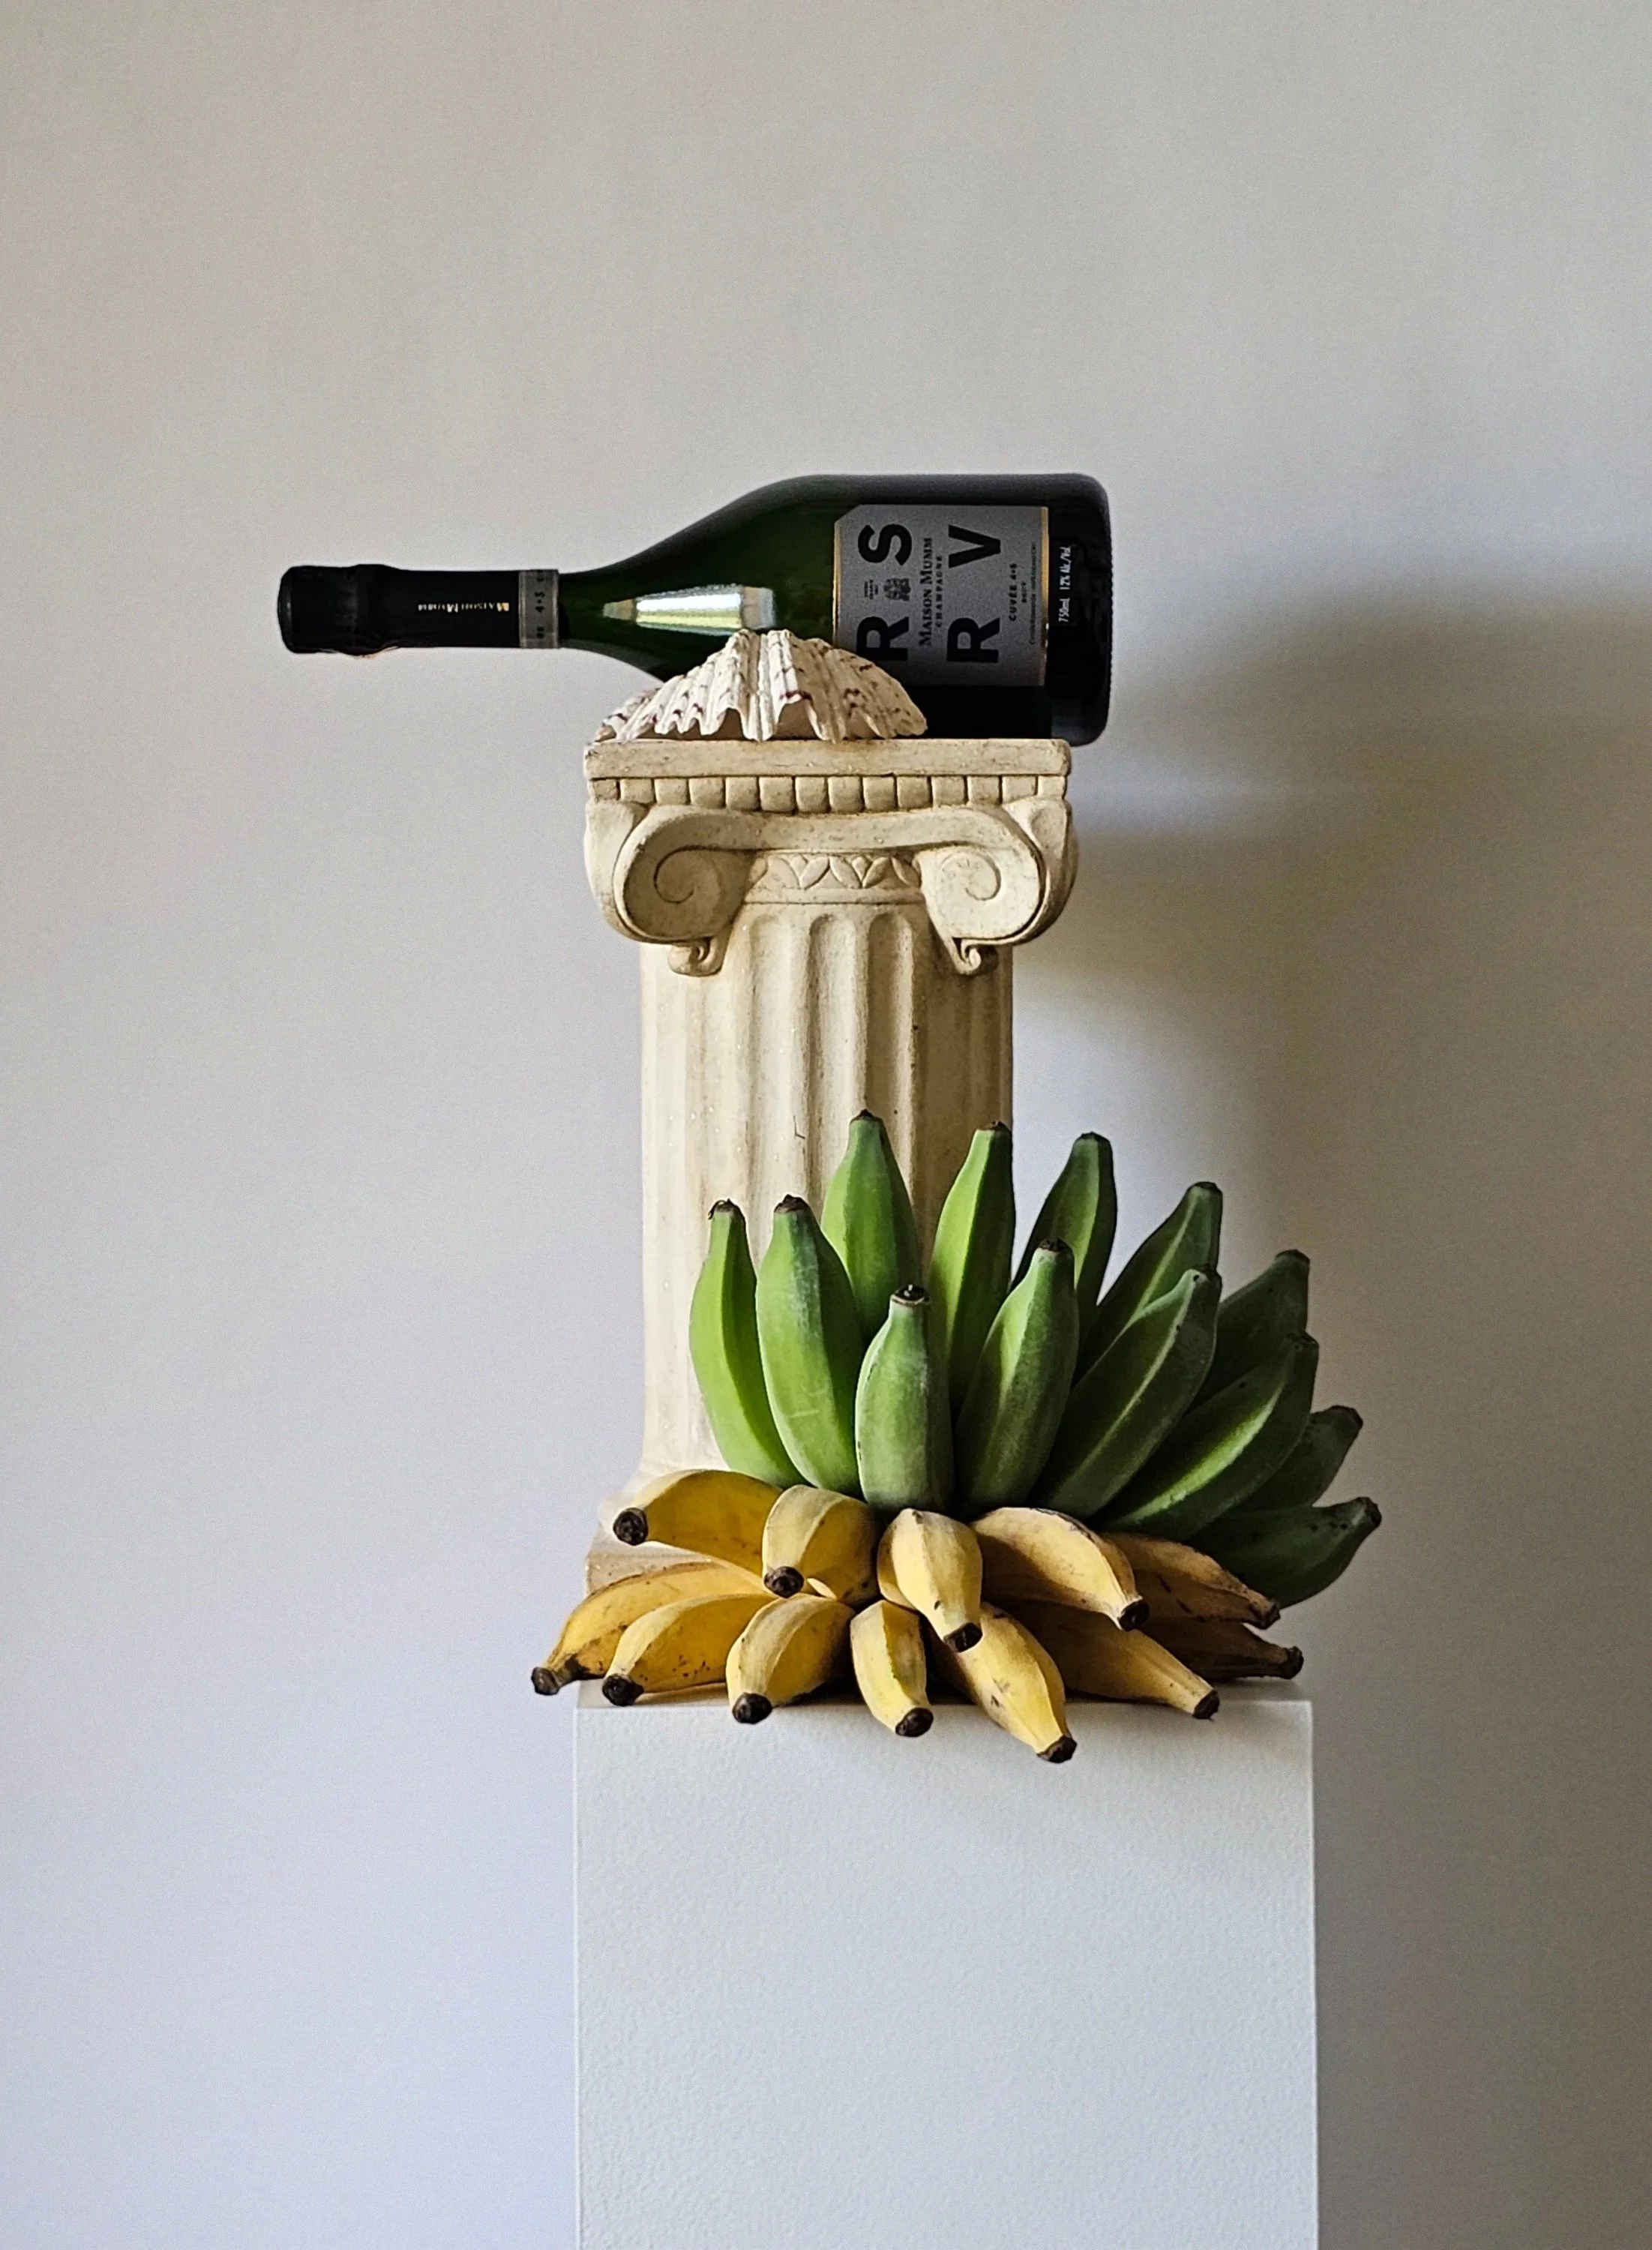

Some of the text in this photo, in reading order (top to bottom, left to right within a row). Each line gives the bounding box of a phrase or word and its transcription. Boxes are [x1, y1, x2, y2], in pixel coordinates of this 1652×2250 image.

[856, 524, 912, 661] R S
[919, 538, 932, 646] MAISON MUMM
[946, 525, 1001, 663] R V
